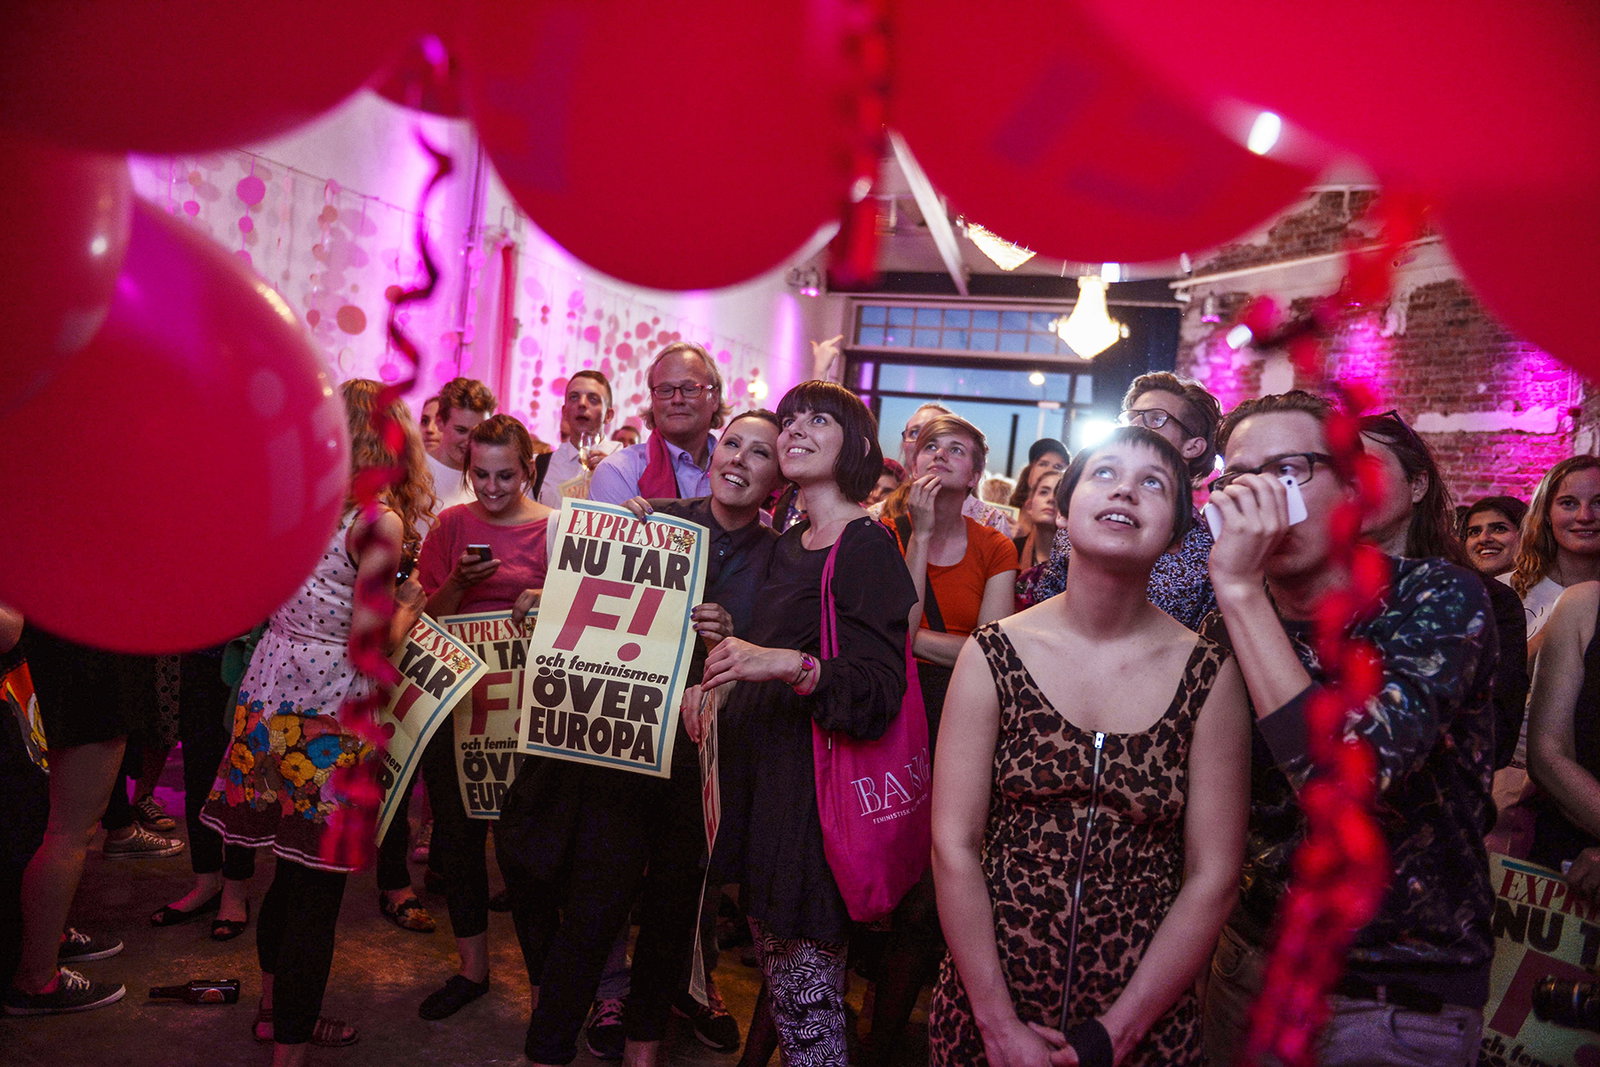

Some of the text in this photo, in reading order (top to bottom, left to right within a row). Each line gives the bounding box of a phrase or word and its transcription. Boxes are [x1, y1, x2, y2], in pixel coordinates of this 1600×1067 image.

[565, 508, 697, 554] EXPRESSEN
[558, 535, 691, 592] NU TAR
[552, 576, 666, 662] F!
[398, 641, 457, 700] TAR
[493, 639, 532, 671] TA
[535, 652, 669, 685] och feminismen
[532, 666, 664, 725] ÖVER
[461, 737, 518, 751] och femin
[528, 706, 655, 764] EUROPA
[1493, 898, 1565, 953] NU
